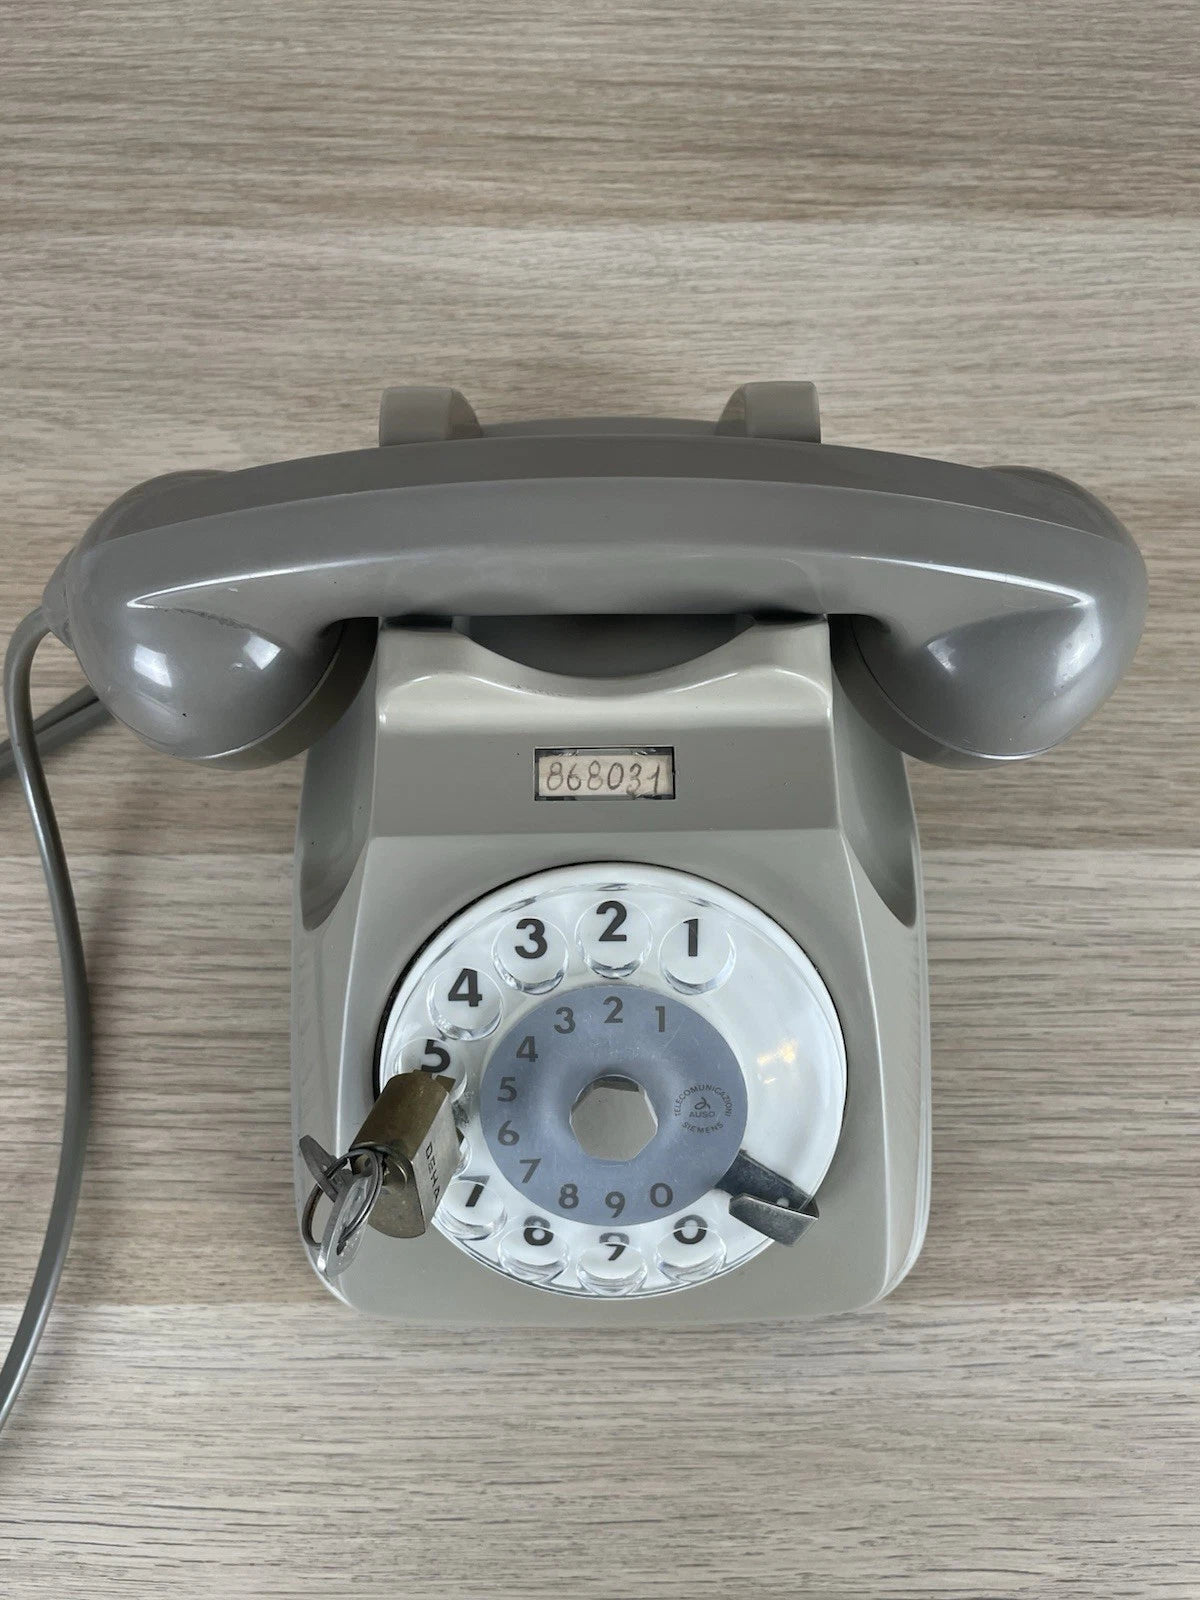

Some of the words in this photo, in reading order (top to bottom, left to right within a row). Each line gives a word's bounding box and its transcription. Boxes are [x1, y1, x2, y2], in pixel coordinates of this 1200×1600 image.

[546, 759, 661, 796] 868031
[596, 900, 628, 942] 2
[514, 918, 548, 960] 3
[683, 918, 700, 957] 1
[448, 968, 483, 1007] 4
[554, 1006, 576, 1034] 3
[603, 996, 624, 1024] 2
[655, 1006, 666, 1032] 1
[420, 1039, 451, 1074] 5
[516, 1035, 539, 1063] 4
[497, 1076, 518, 1103] 5
[497, 1120, 520, 1146] 6
[682, 1121, 724, 1134] SIEMENS
[519, 1158, 542, 1184] 7
[558, 1183, 579, 1209] 8
[605, 1191, 626, 1218] 9
[649, 1182, 674, 1208] 0
